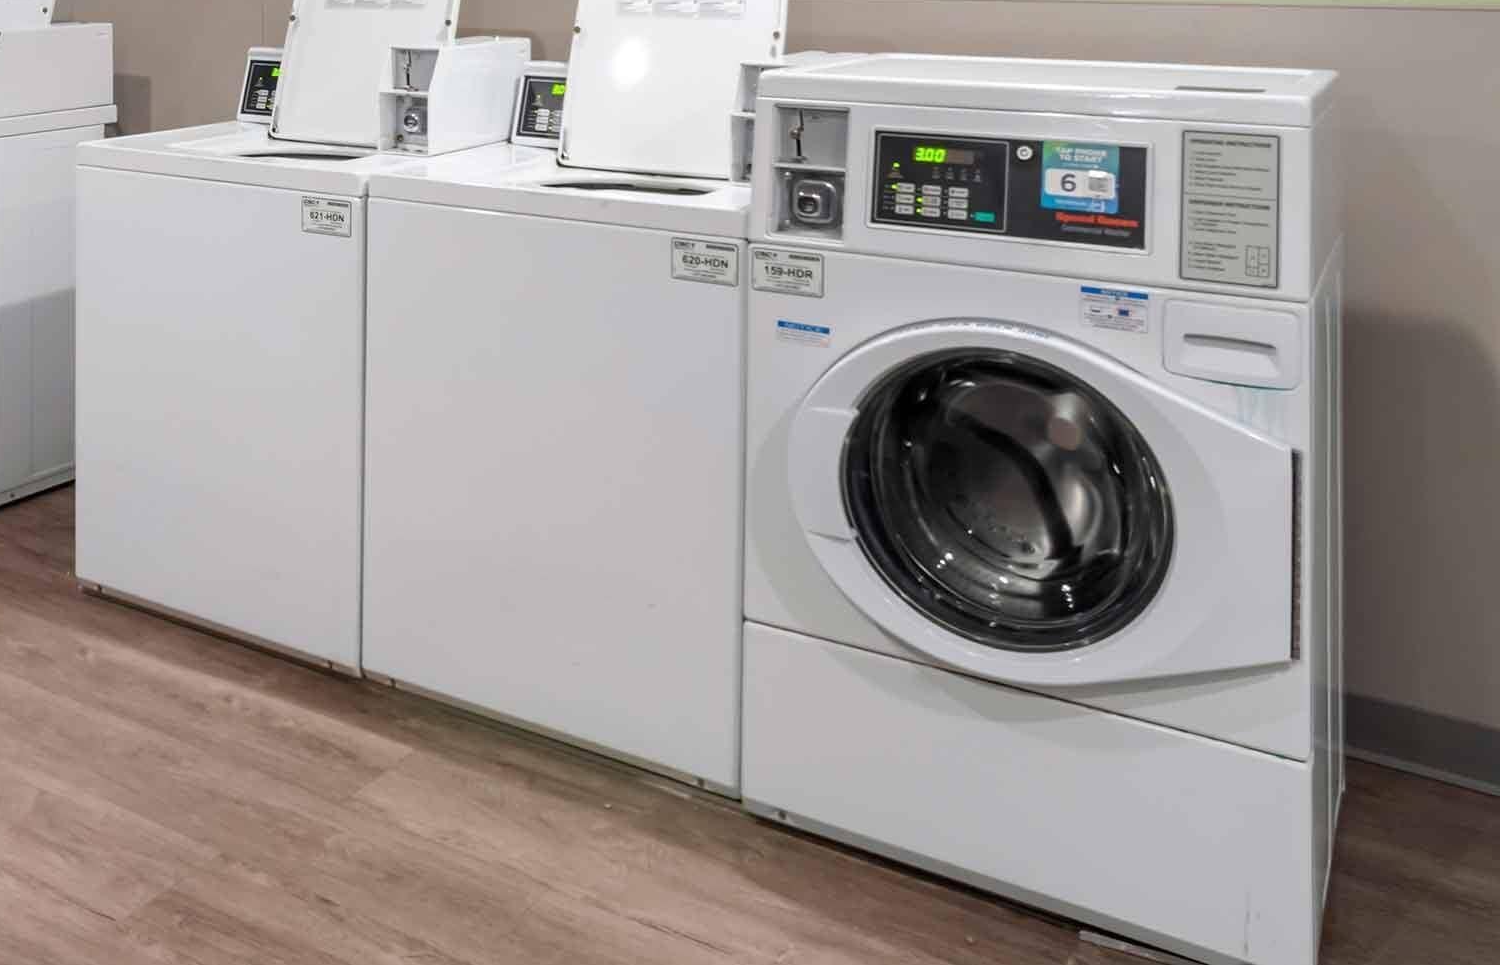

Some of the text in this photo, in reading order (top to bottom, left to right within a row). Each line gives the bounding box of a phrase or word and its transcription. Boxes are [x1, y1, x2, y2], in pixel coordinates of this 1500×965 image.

[1060, 173, 1077, 192] 6
[682, 254, 729, 269] 620-HDN
[764, 265, 813, 279] 159-HDR
